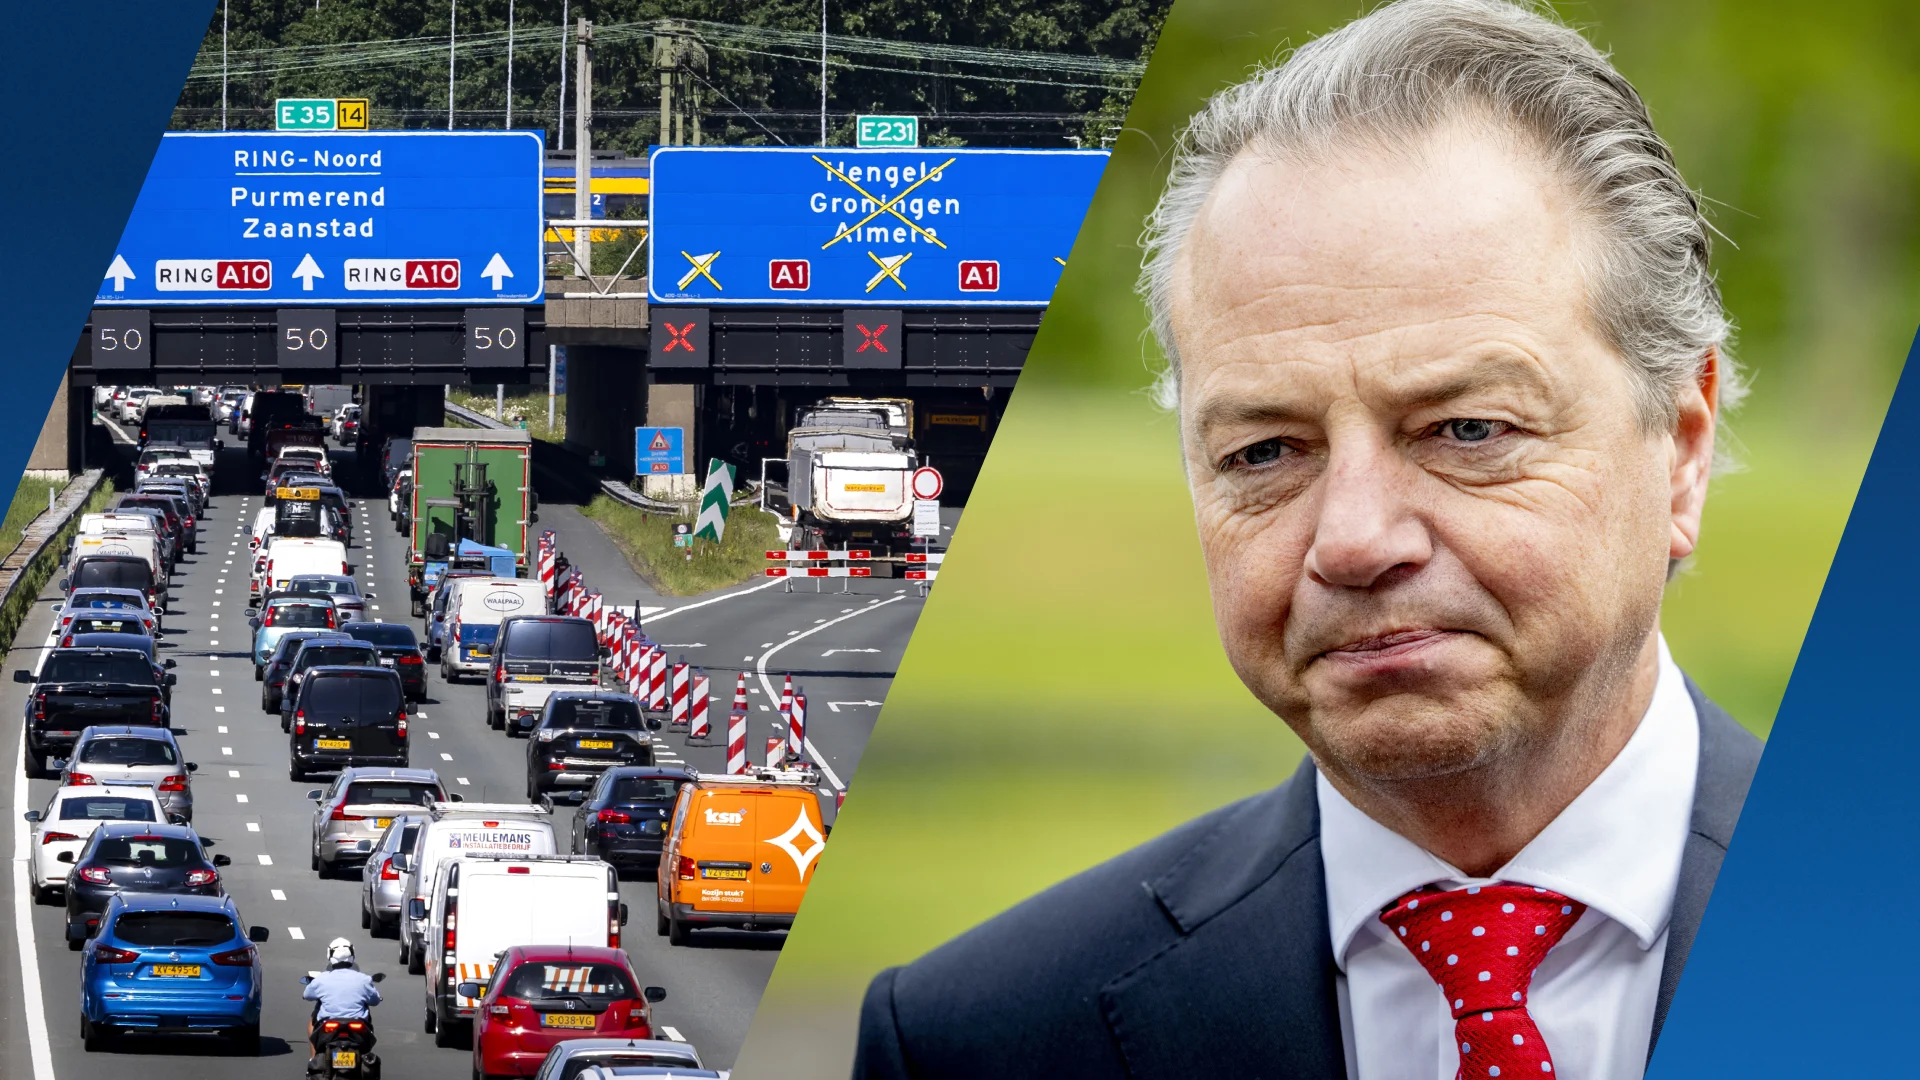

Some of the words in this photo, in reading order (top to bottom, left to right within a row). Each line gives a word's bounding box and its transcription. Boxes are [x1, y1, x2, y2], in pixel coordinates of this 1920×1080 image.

[281, 106, 296, 124] E
[300, 106, 331, 124] 35
[341, 107, 363, 123] 14
[861, 122, 914, 141] E231
[826, 161, 943, 189] Hengelo
[231, 186, 385, 207] Purmerend
[593, 194, 601, 205] 2
[810, 192, 960, 221] Groningen
[243, 217, 374, 238] Zaanstad
[834, 221, 937, 244] Almere
[160, 268, 213, 283] RING
[221, 264, 269, 285] A10
[349, 267, 402, 283] RING
[410, 264, 457, 284] A10
[775, 265, 804, 285] A1
[965, 265, 994, 286] A1
[100, 327, 142, 351] 50
[286, 327, 328, 351] 50
[474, 326, 516, 350] 50
[704, 808, 743, 824] ksn
[463, 833, 531, 843] MEULEMANS
[156, 965, 198, 974] XV-495-G
[548, 1015, 592, 1025] S-038-VG
